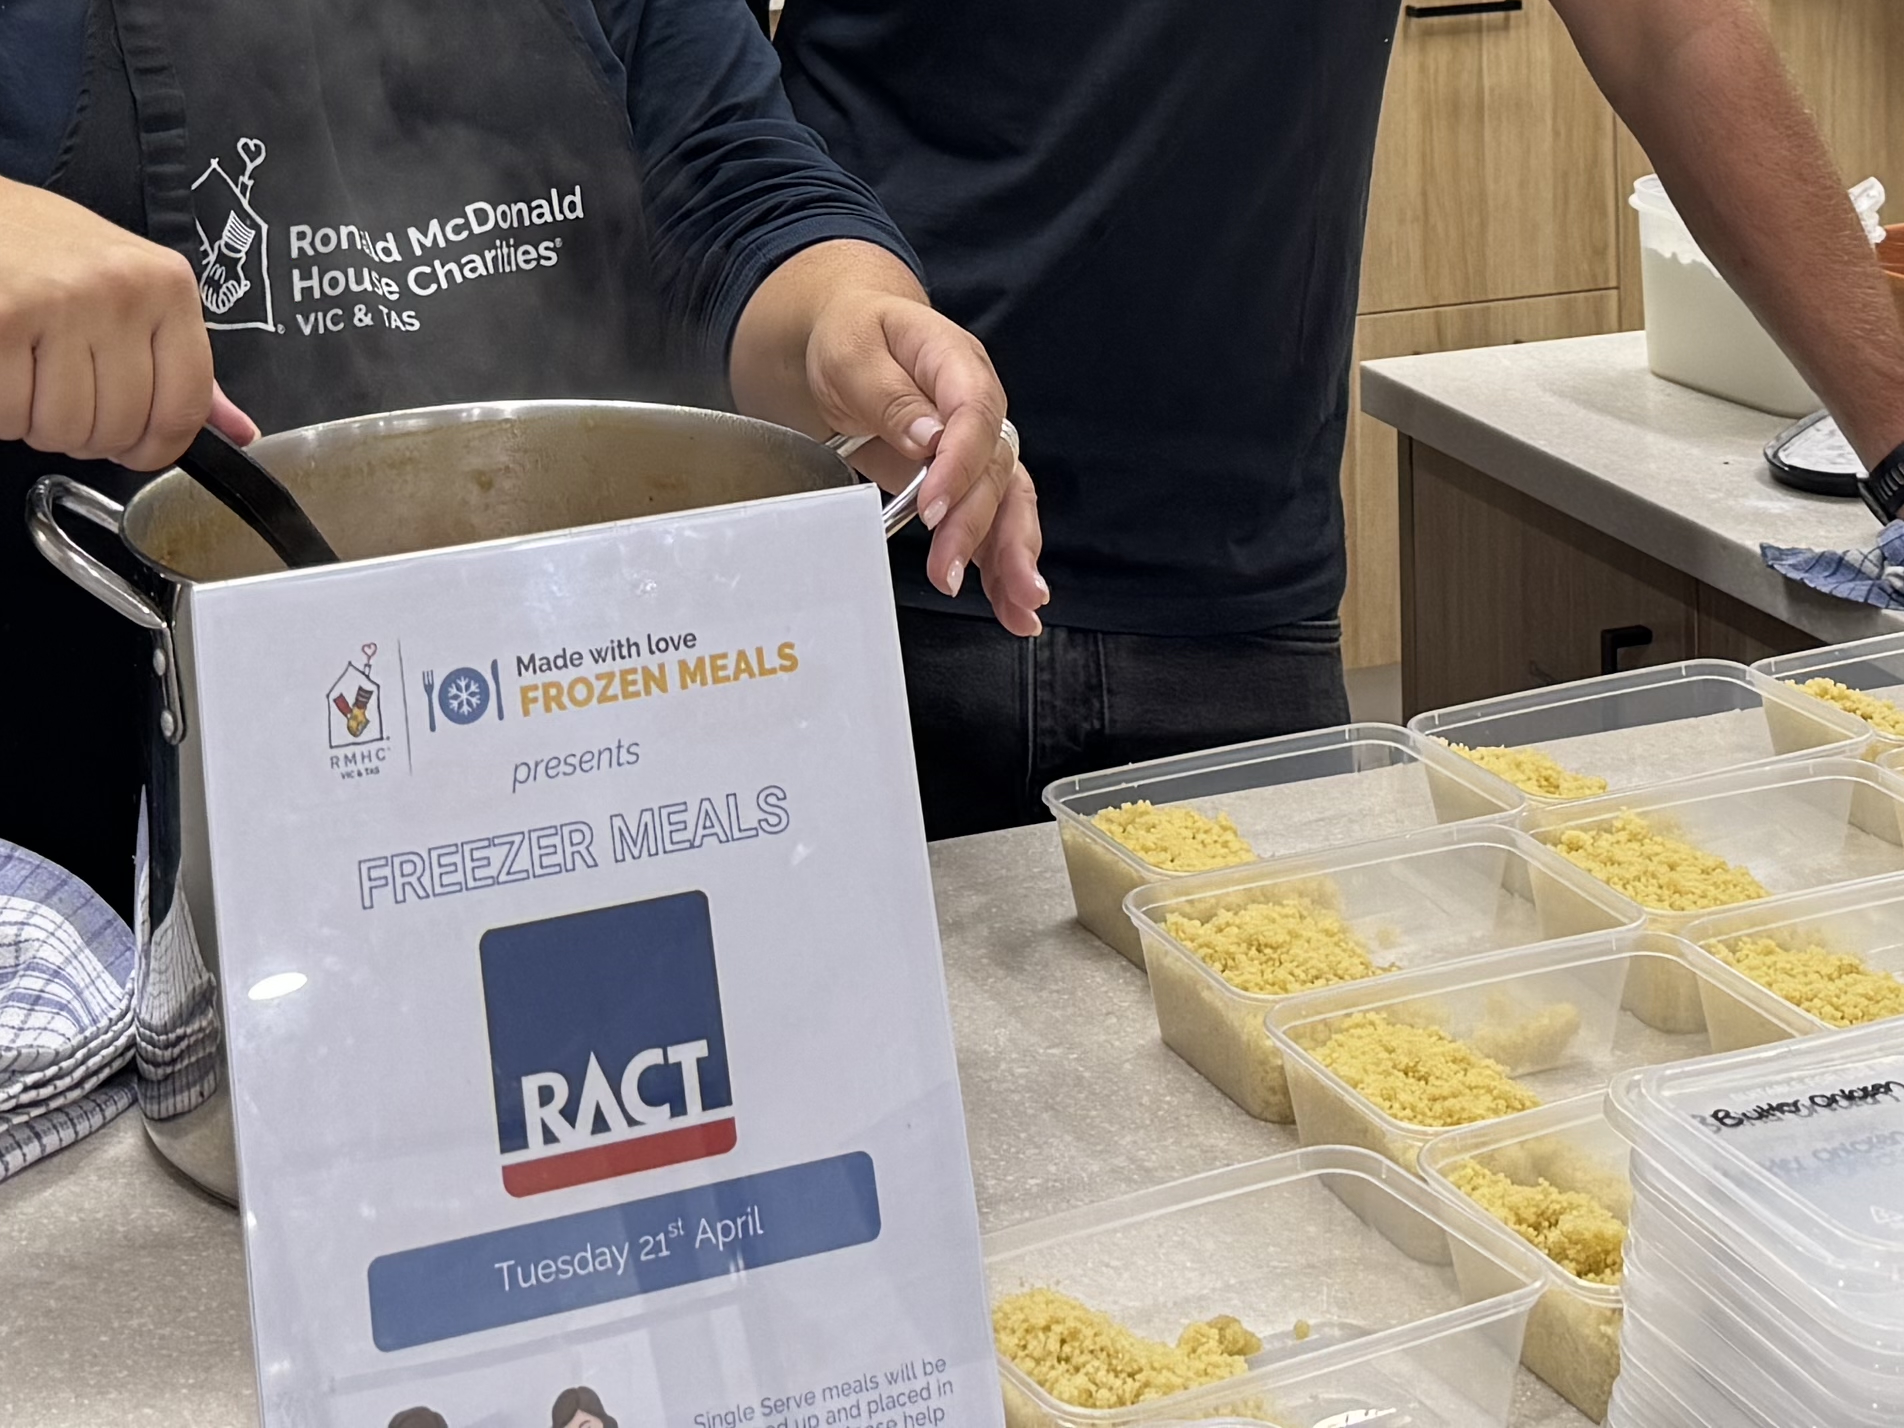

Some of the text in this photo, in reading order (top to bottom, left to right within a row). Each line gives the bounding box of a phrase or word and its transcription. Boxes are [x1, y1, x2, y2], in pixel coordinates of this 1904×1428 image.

[406, 185, 585, 257] McDonald
[293, 266, 400, 302] House
[296, 305, 421, 336] VIC & TAS
[516, 631, 697, 677] Made with love
[519, 642, 799, 718] FROZEN MEALS
[330, 748, 387, 770] RMHC
[340, 770, 355, 781] VIC
[365, 766, 380, 777] TAS
[512, 738, 640, 793] presents
[358, 785, 791, 910] FREEZER MEALS
[521, 1039, 709, 1148] RACT
[495, 1205, 765, 1292] Tuesday 21st April
[694, 1357, 947, 1428] Single Serve meals will be
[825, 1400, 862, 1426] and
[866, 1381, 932, 1417] placed
[937, 1378, 954, 1396] in
[903, 1406, 946, 1428] help
